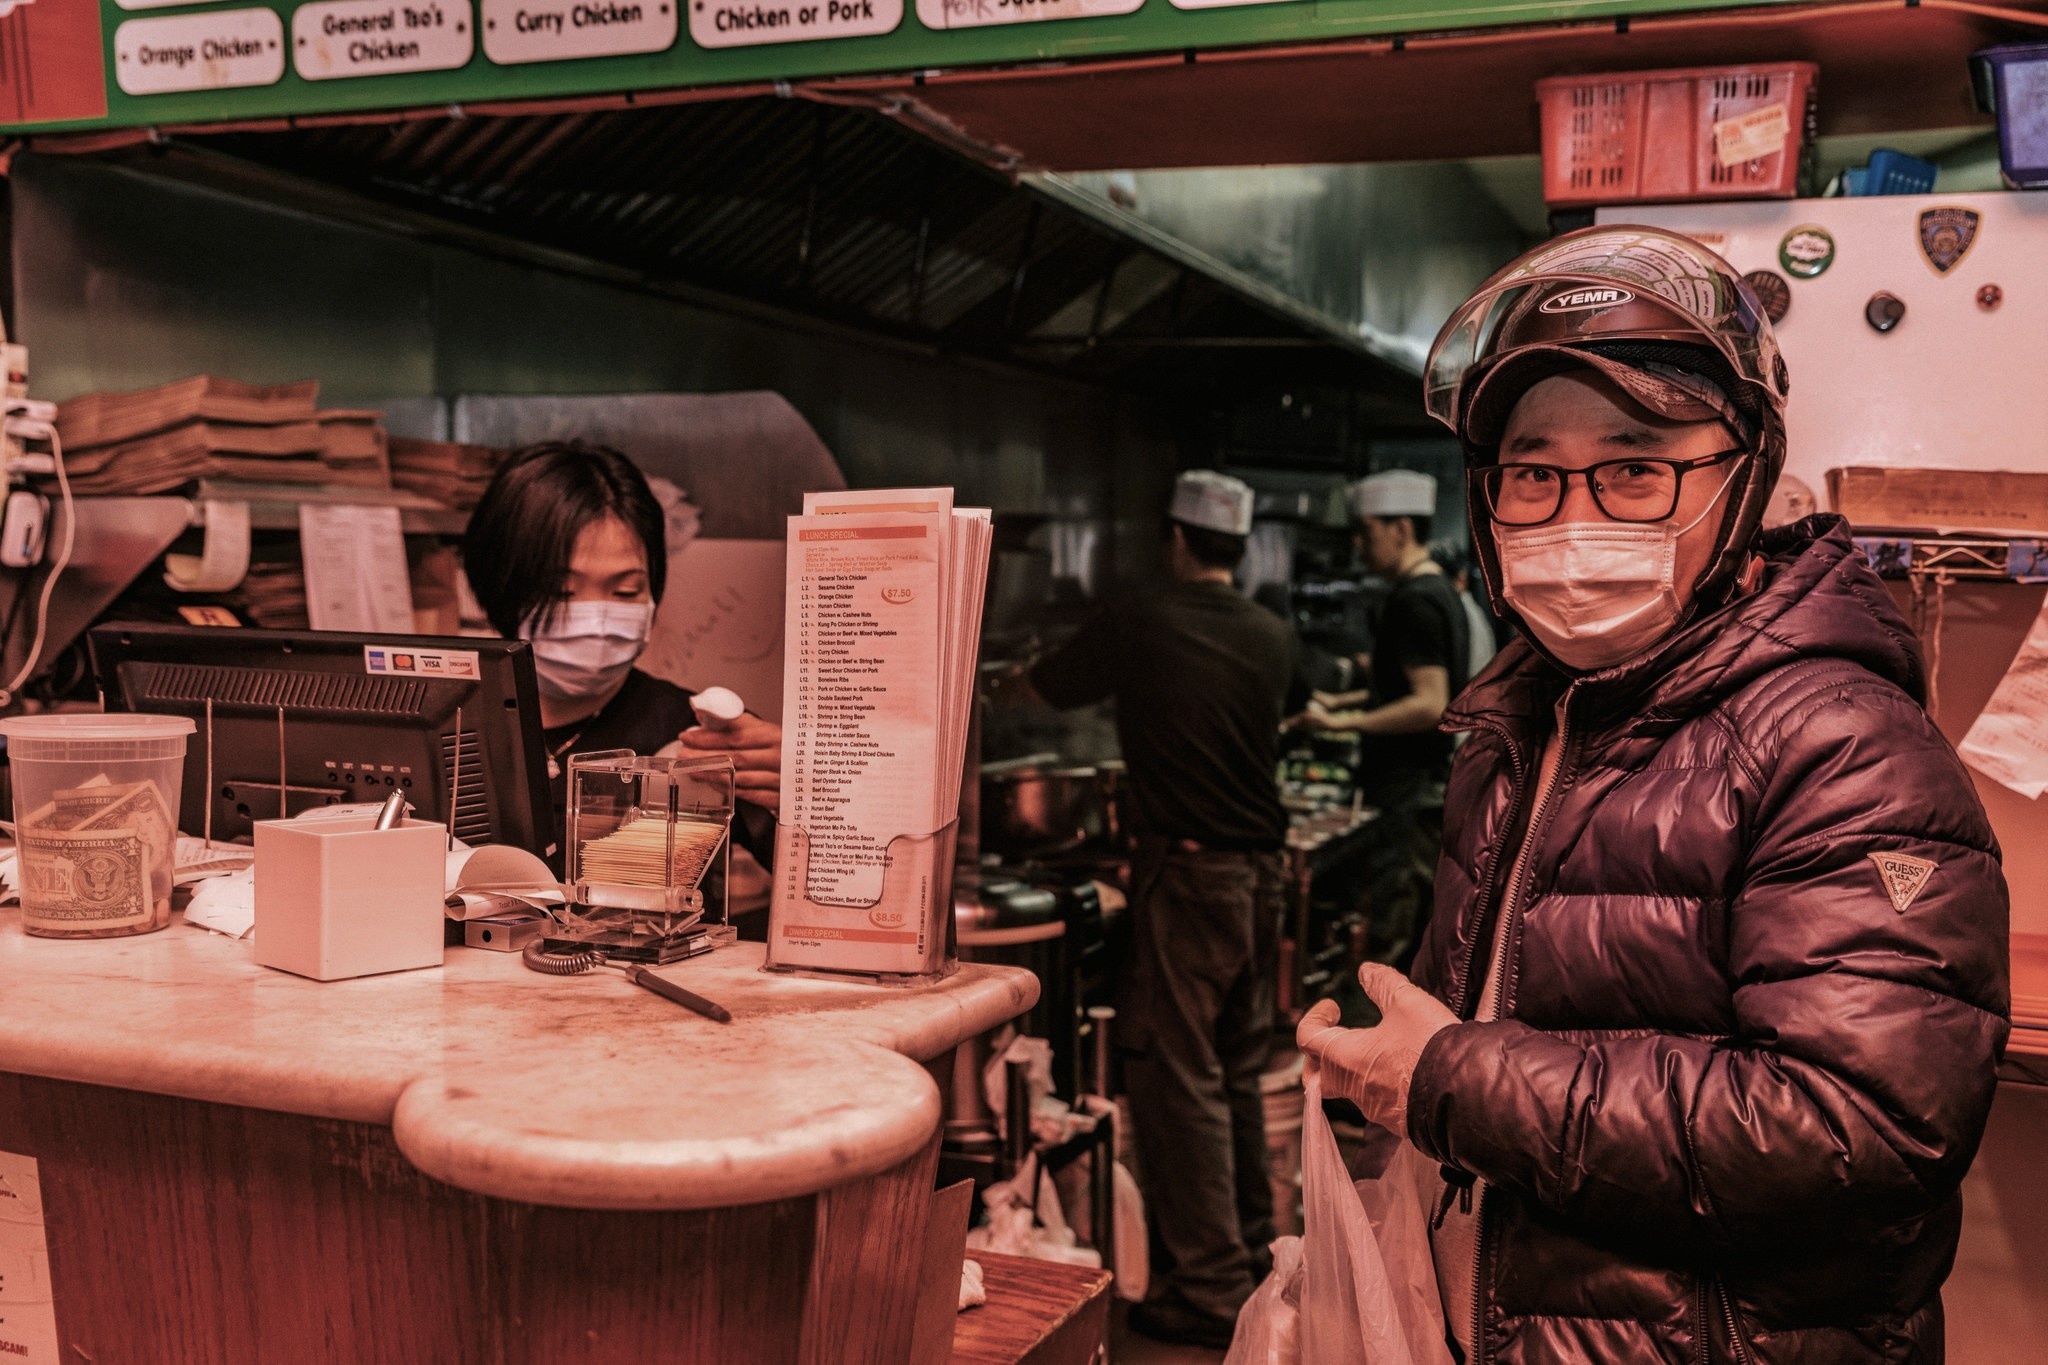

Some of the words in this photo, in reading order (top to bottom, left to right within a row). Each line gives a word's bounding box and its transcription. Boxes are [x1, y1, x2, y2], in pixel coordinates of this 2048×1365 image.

[323, 10, 395, 36] General
[404, 3, 443, 28] Tso's
[515, 10, 565, 36] Curry
[573, 3, 642, 28] Chicken
[716, 8, 789, 33] Chicken
[799, 5, 818, 25] or
[828, 0, 873, 21] Pork
[139, 44, 195, 68] Orange
[202, 39, 263, 62] Chicken
[348, 41, 419, 63] Chicken
[1557, 290, 1618, 307] YEMA
[806, 532, 828, 540] LUNCH
[830, 531, 859, 539] SPECIAL
[887, 588, 911, 598] $7.50
[423, 660, 441, 668] VISA
[875, 913, 902, 922] $8.50
[789, 928, 813, 936] DINNER
[815, 929, 844, 939] SPECIAL
